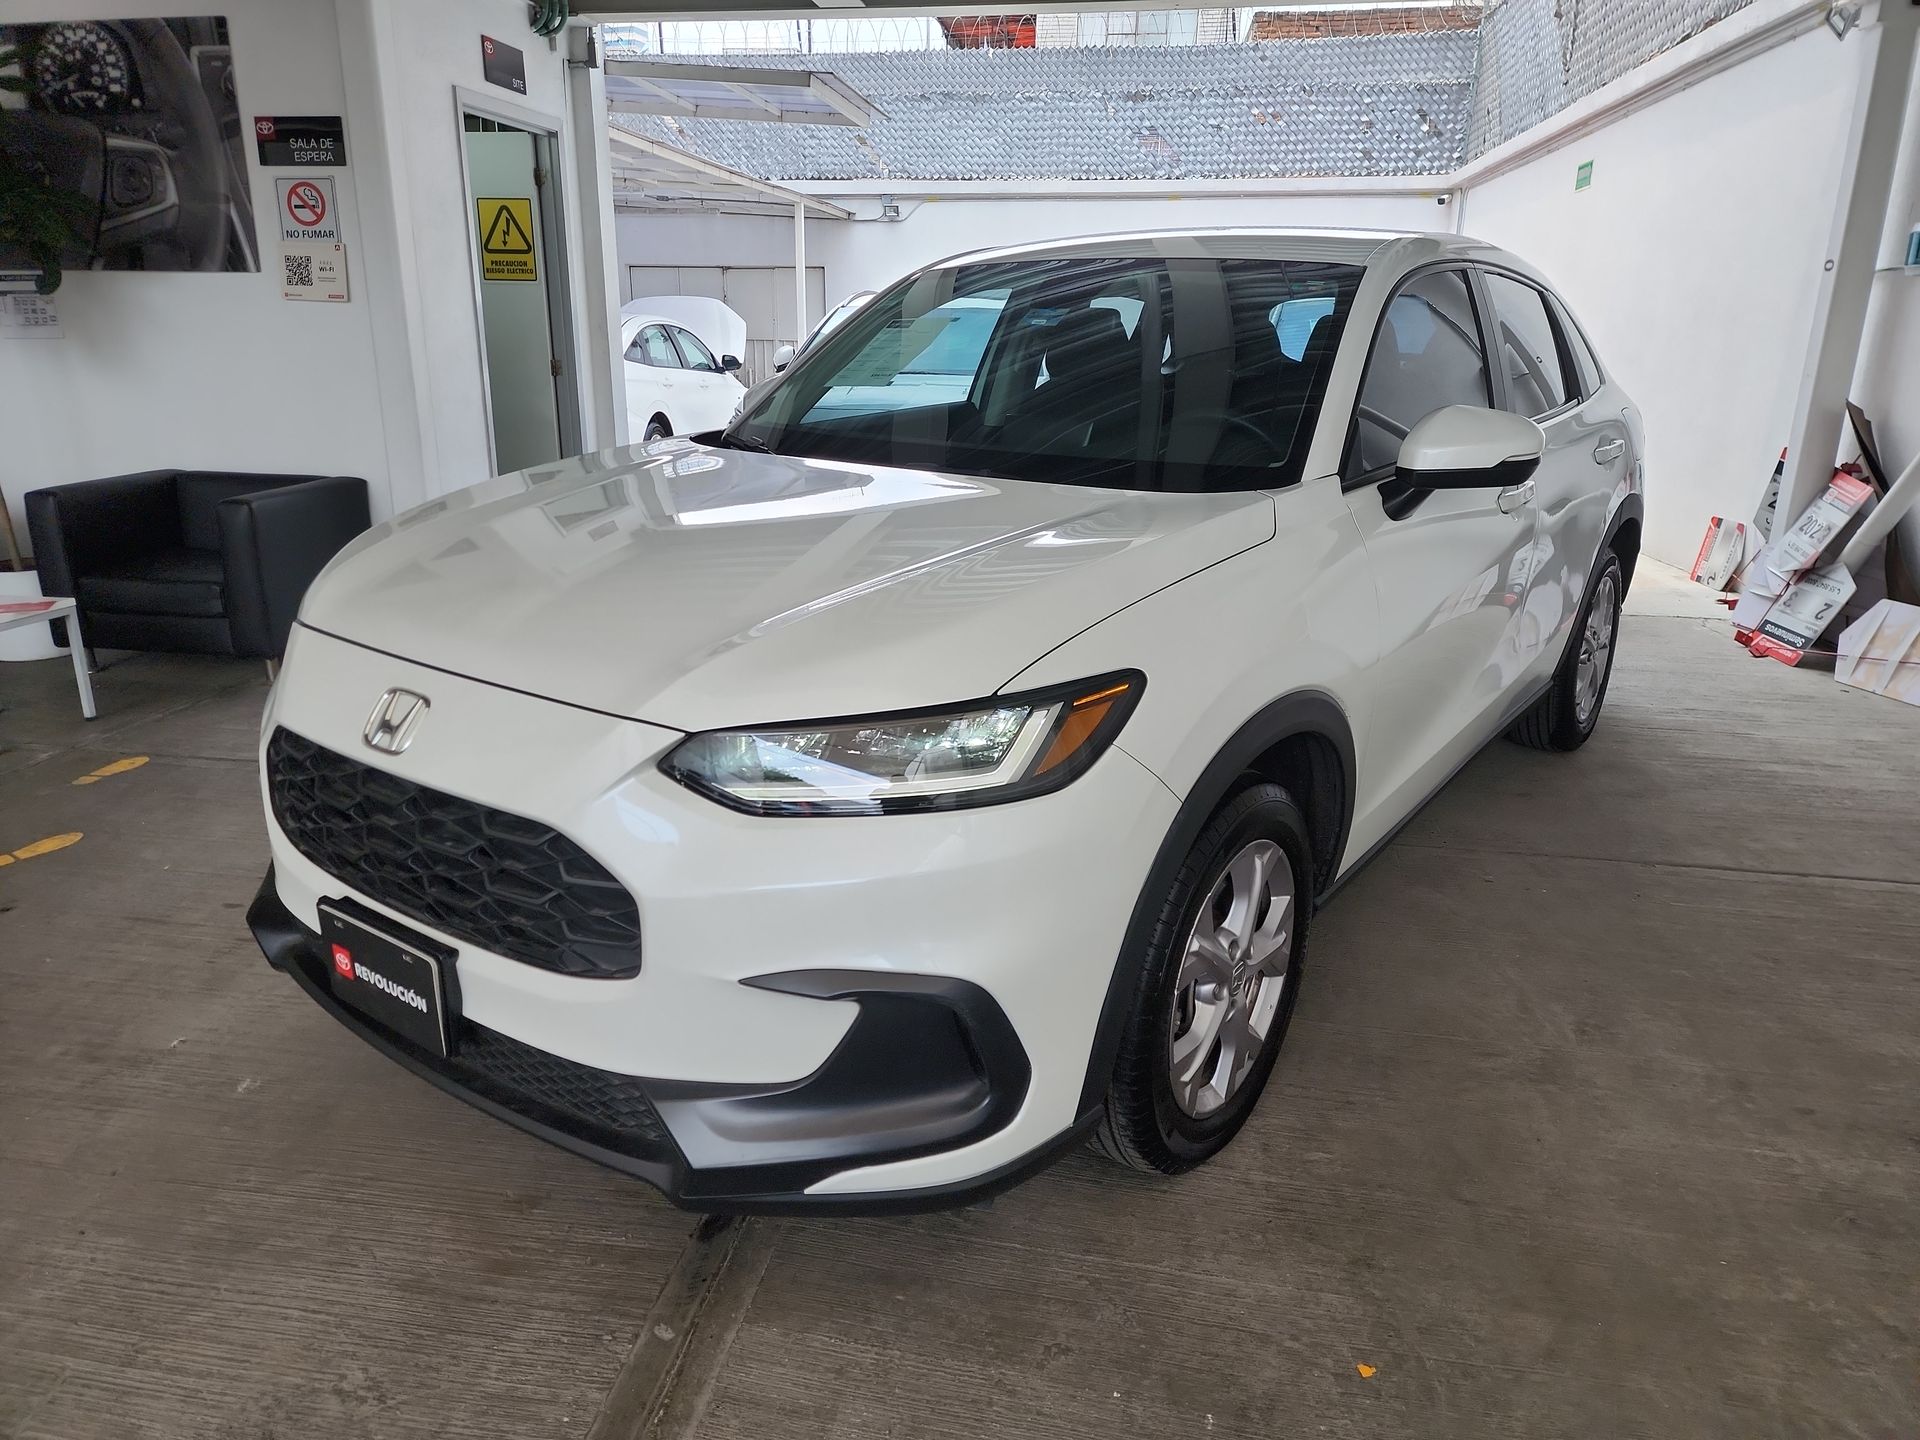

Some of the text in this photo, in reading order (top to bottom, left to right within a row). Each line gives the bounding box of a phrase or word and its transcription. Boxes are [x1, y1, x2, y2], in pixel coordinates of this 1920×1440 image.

[512, 78, 525, 91] SITE
[289, 138, 334, 149] SALA DE
[294, 151, 334, 162] ESPERA
[286, 230, 335, 239] NO FUMAR
[1764, 623, 1805, 648] Seminuevos
[354, 962, 428, 1014] REVOLUCIÓN
